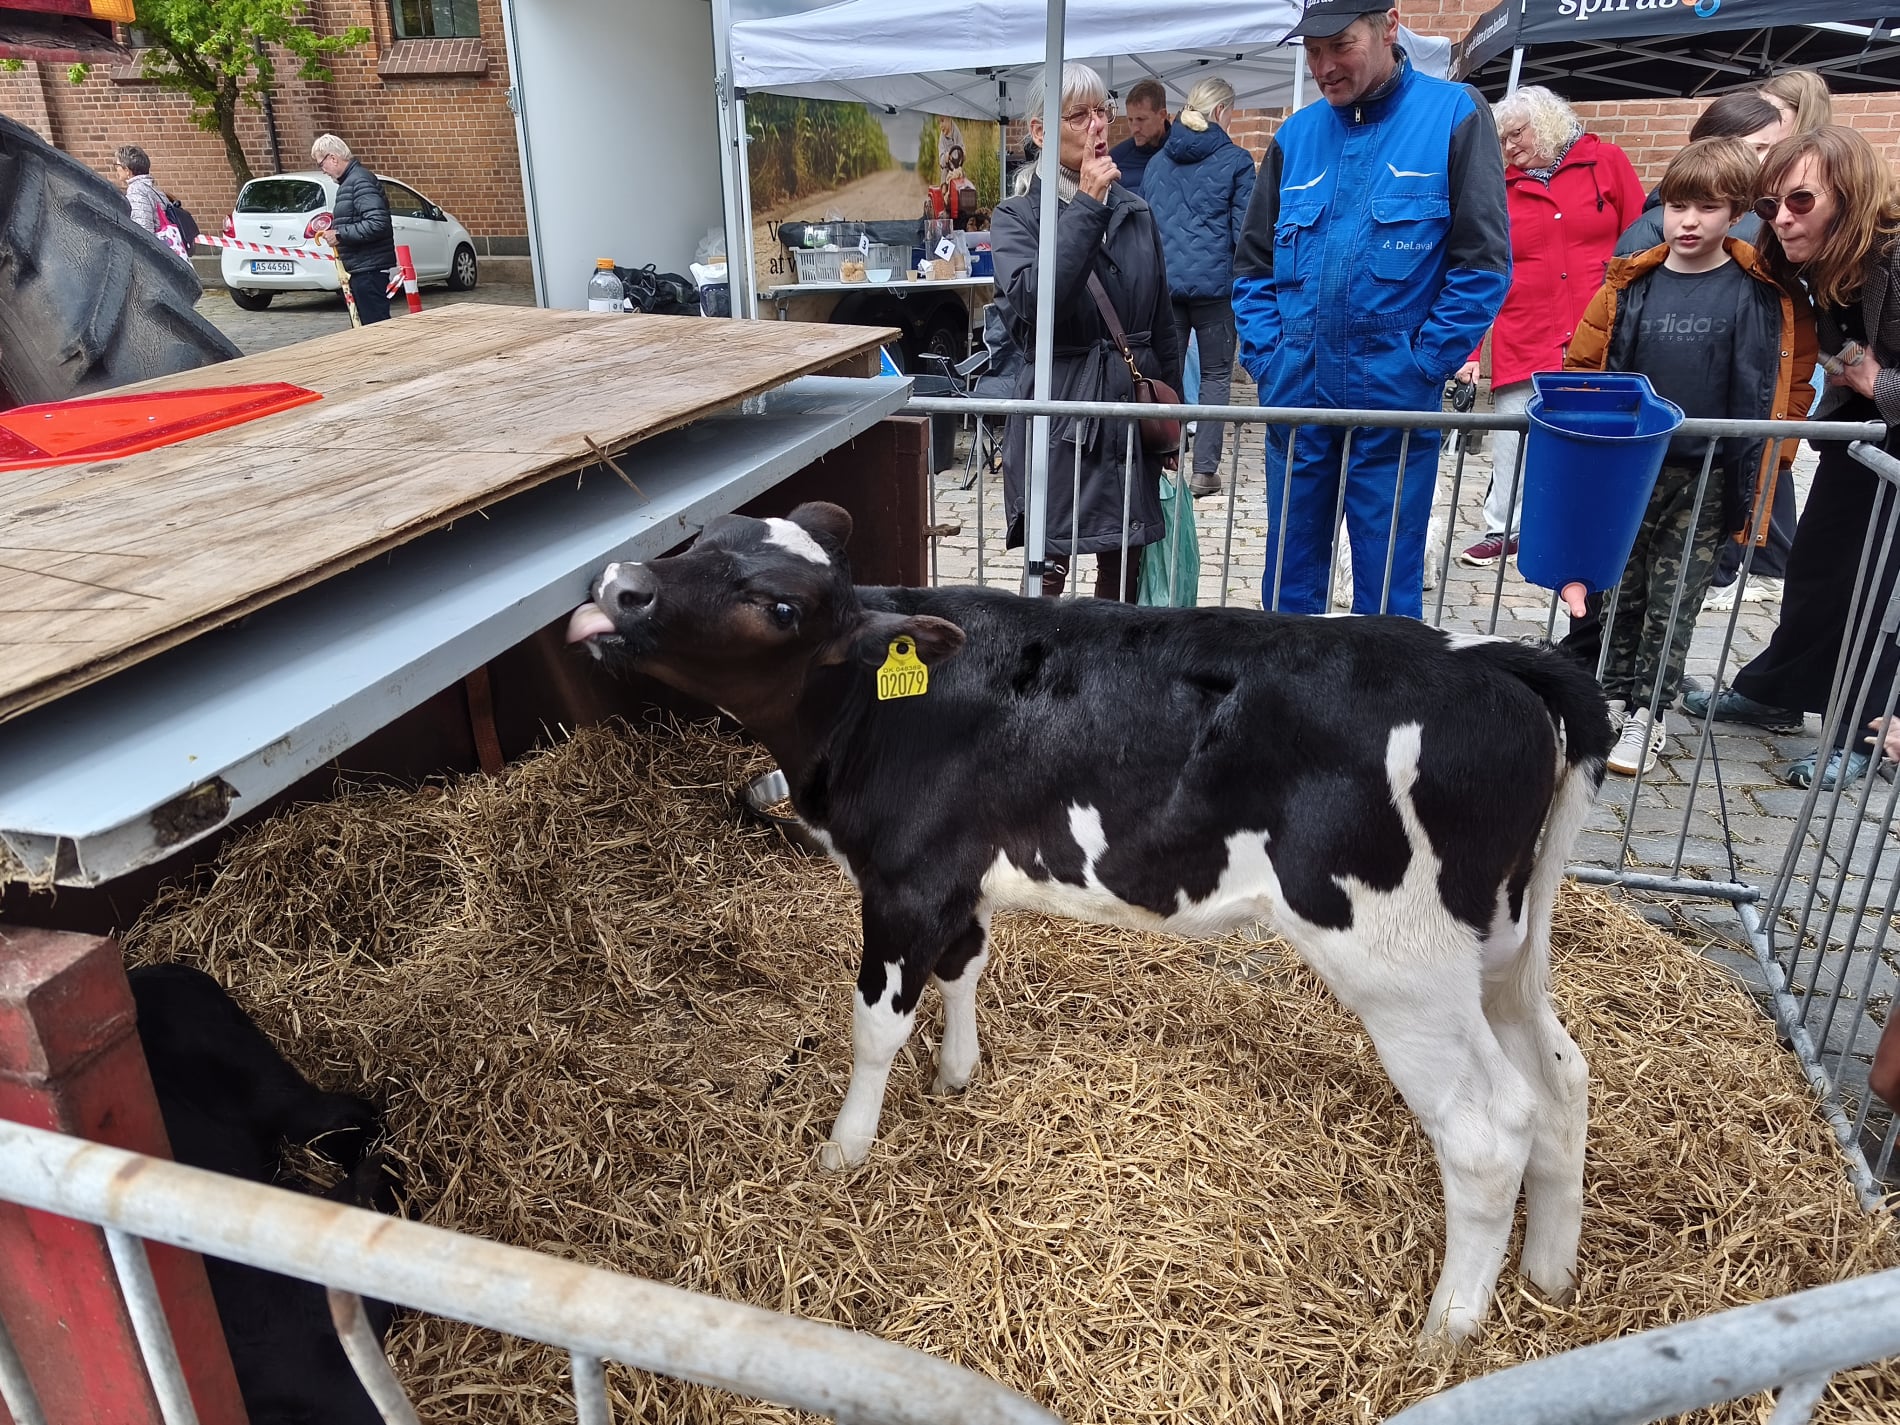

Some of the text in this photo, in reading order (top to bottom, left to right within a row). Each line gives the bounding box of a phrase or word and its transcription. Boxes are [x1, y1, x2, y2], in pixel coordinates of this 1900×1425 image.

[861, 240, 867, 250] 3
[940, 245, 949, 255] 4
[1395, 240, 1433, 251] DeLaval
[256, 262, 266, 271] AS
[267, 263, 277, 271] 44
[278, 263, 291, 272] 561
[1640, 313, 1728, 334] adidas
[880, 670, 925, 698] 02079
